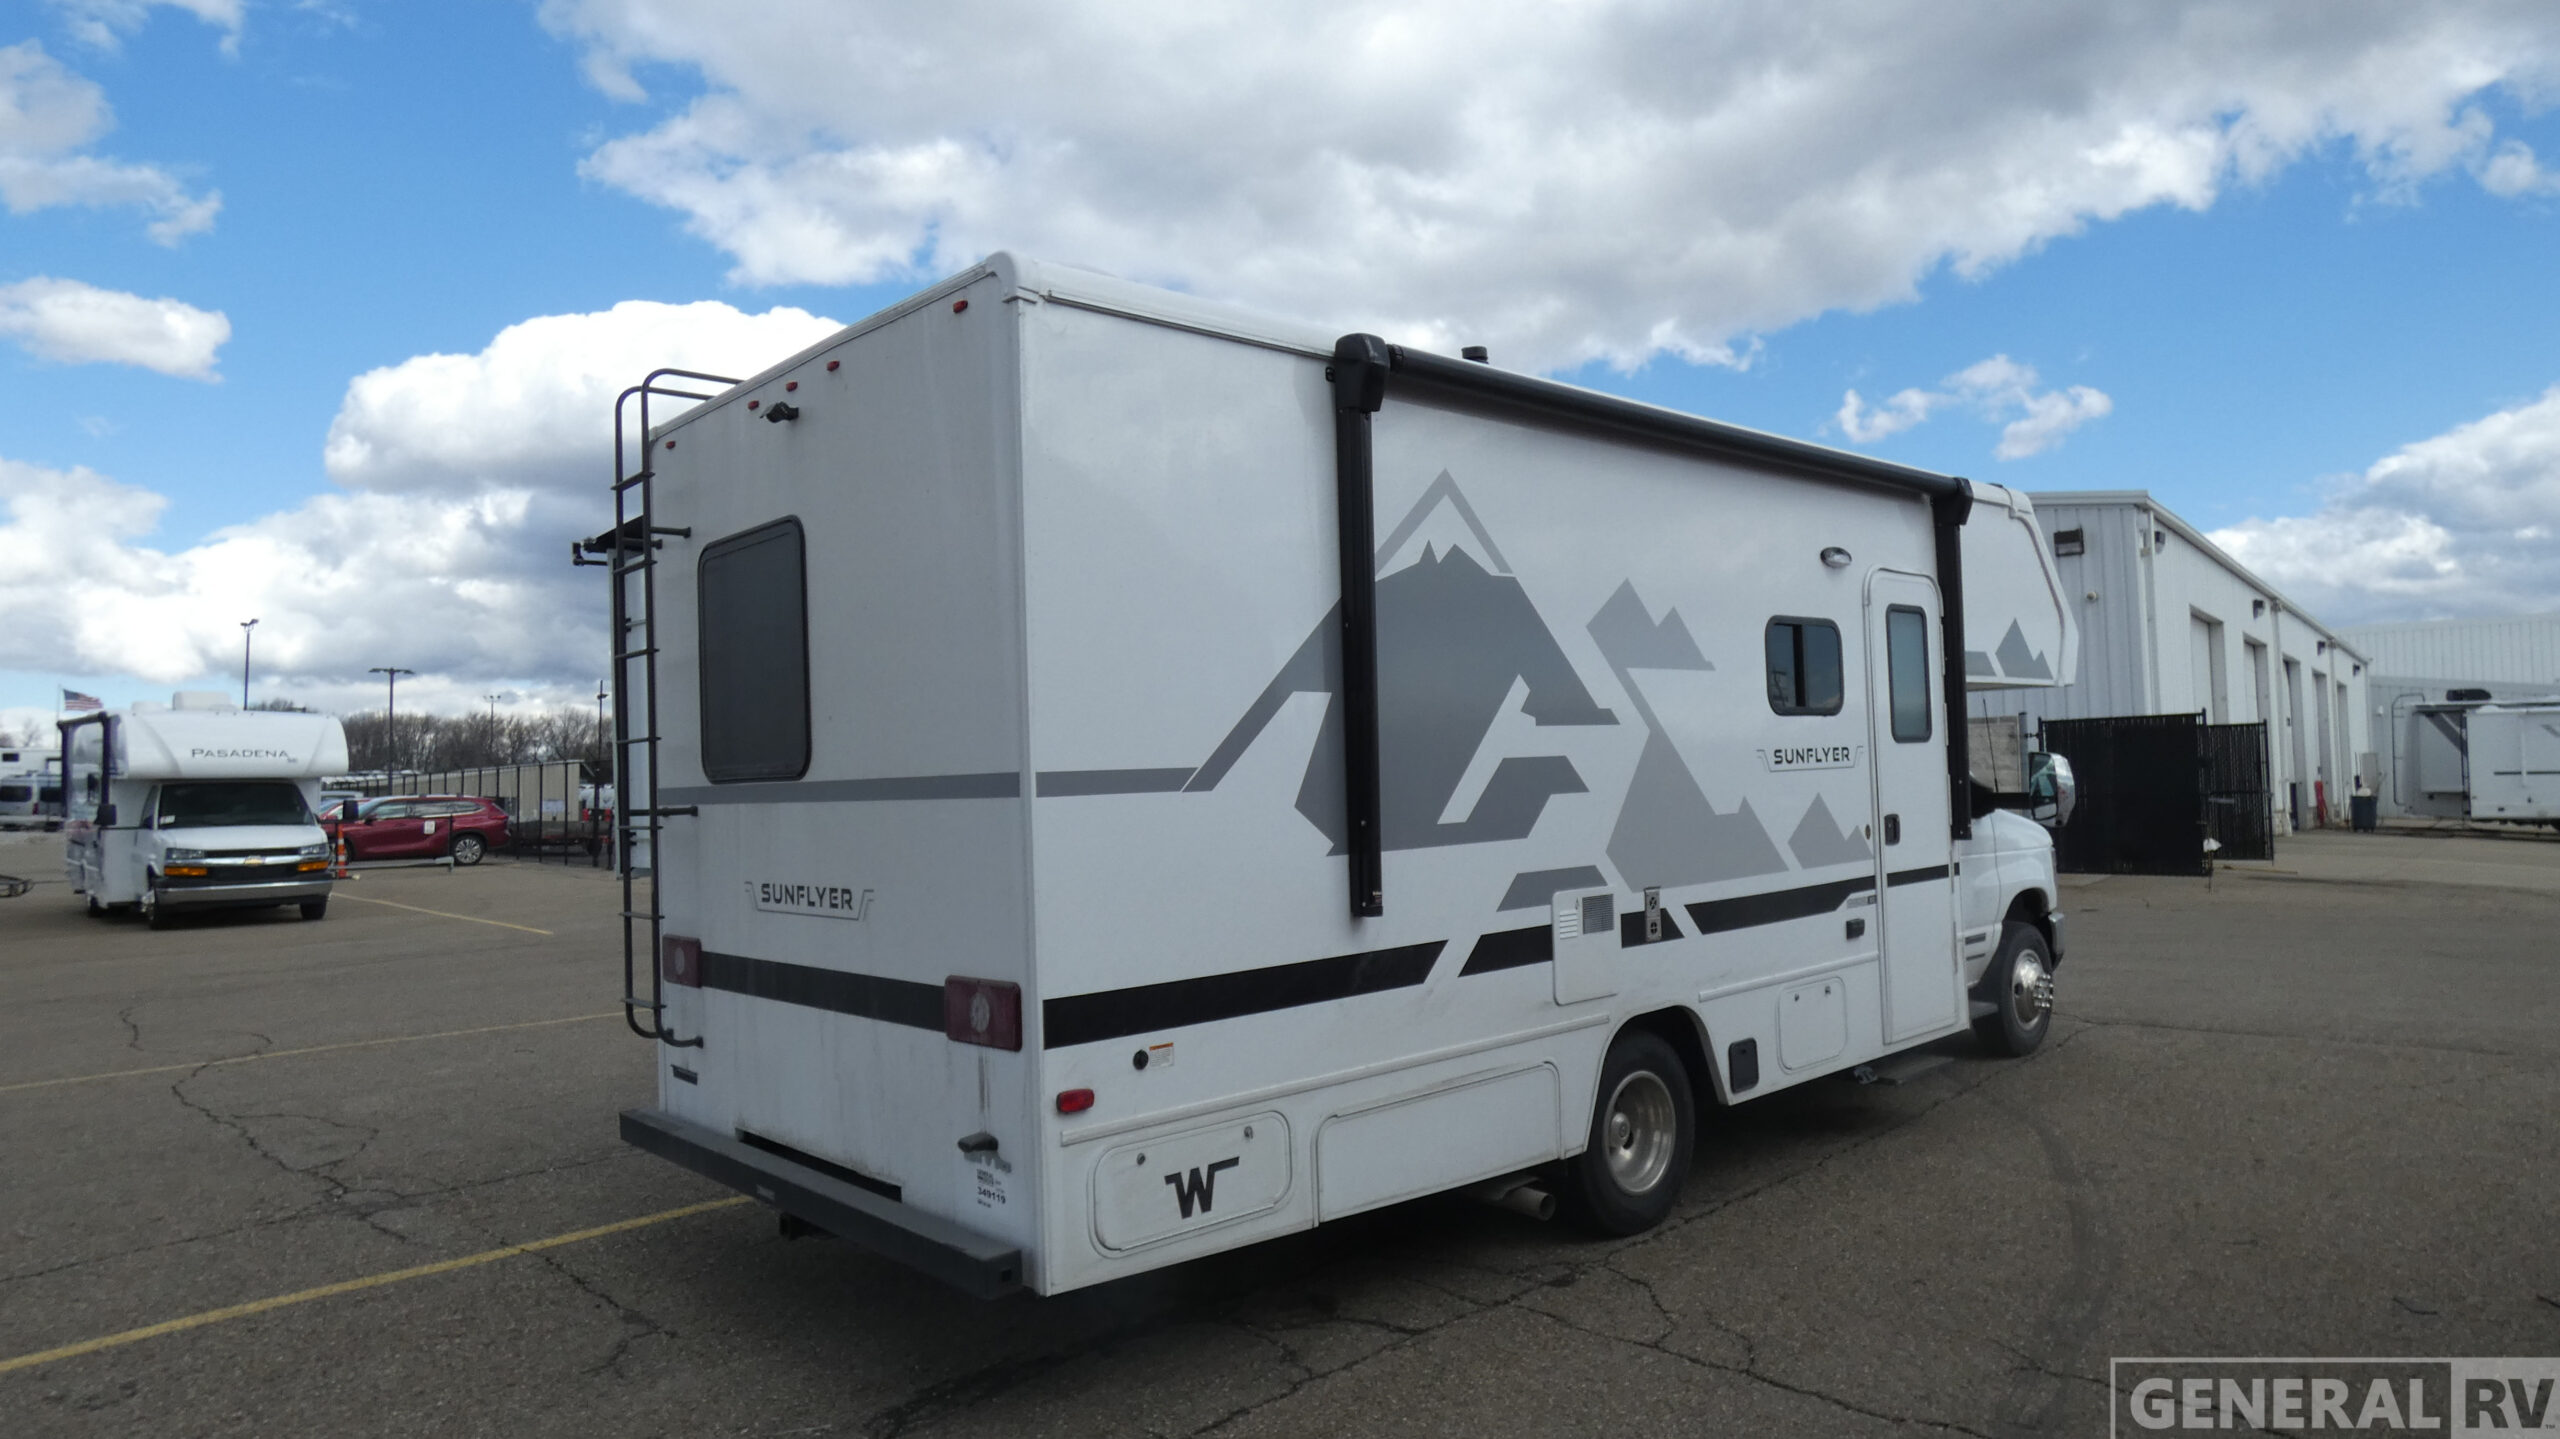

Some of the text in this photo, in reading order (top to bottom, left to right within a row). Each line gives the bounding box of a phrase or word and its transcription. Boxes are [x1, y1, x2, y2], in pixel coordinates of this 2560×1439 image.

[191, 747, 288, 759] PASADENA
[1773, 747, 1850, 765] SUNFLYER
[760, 883, 853, 911] SUNFLYER
